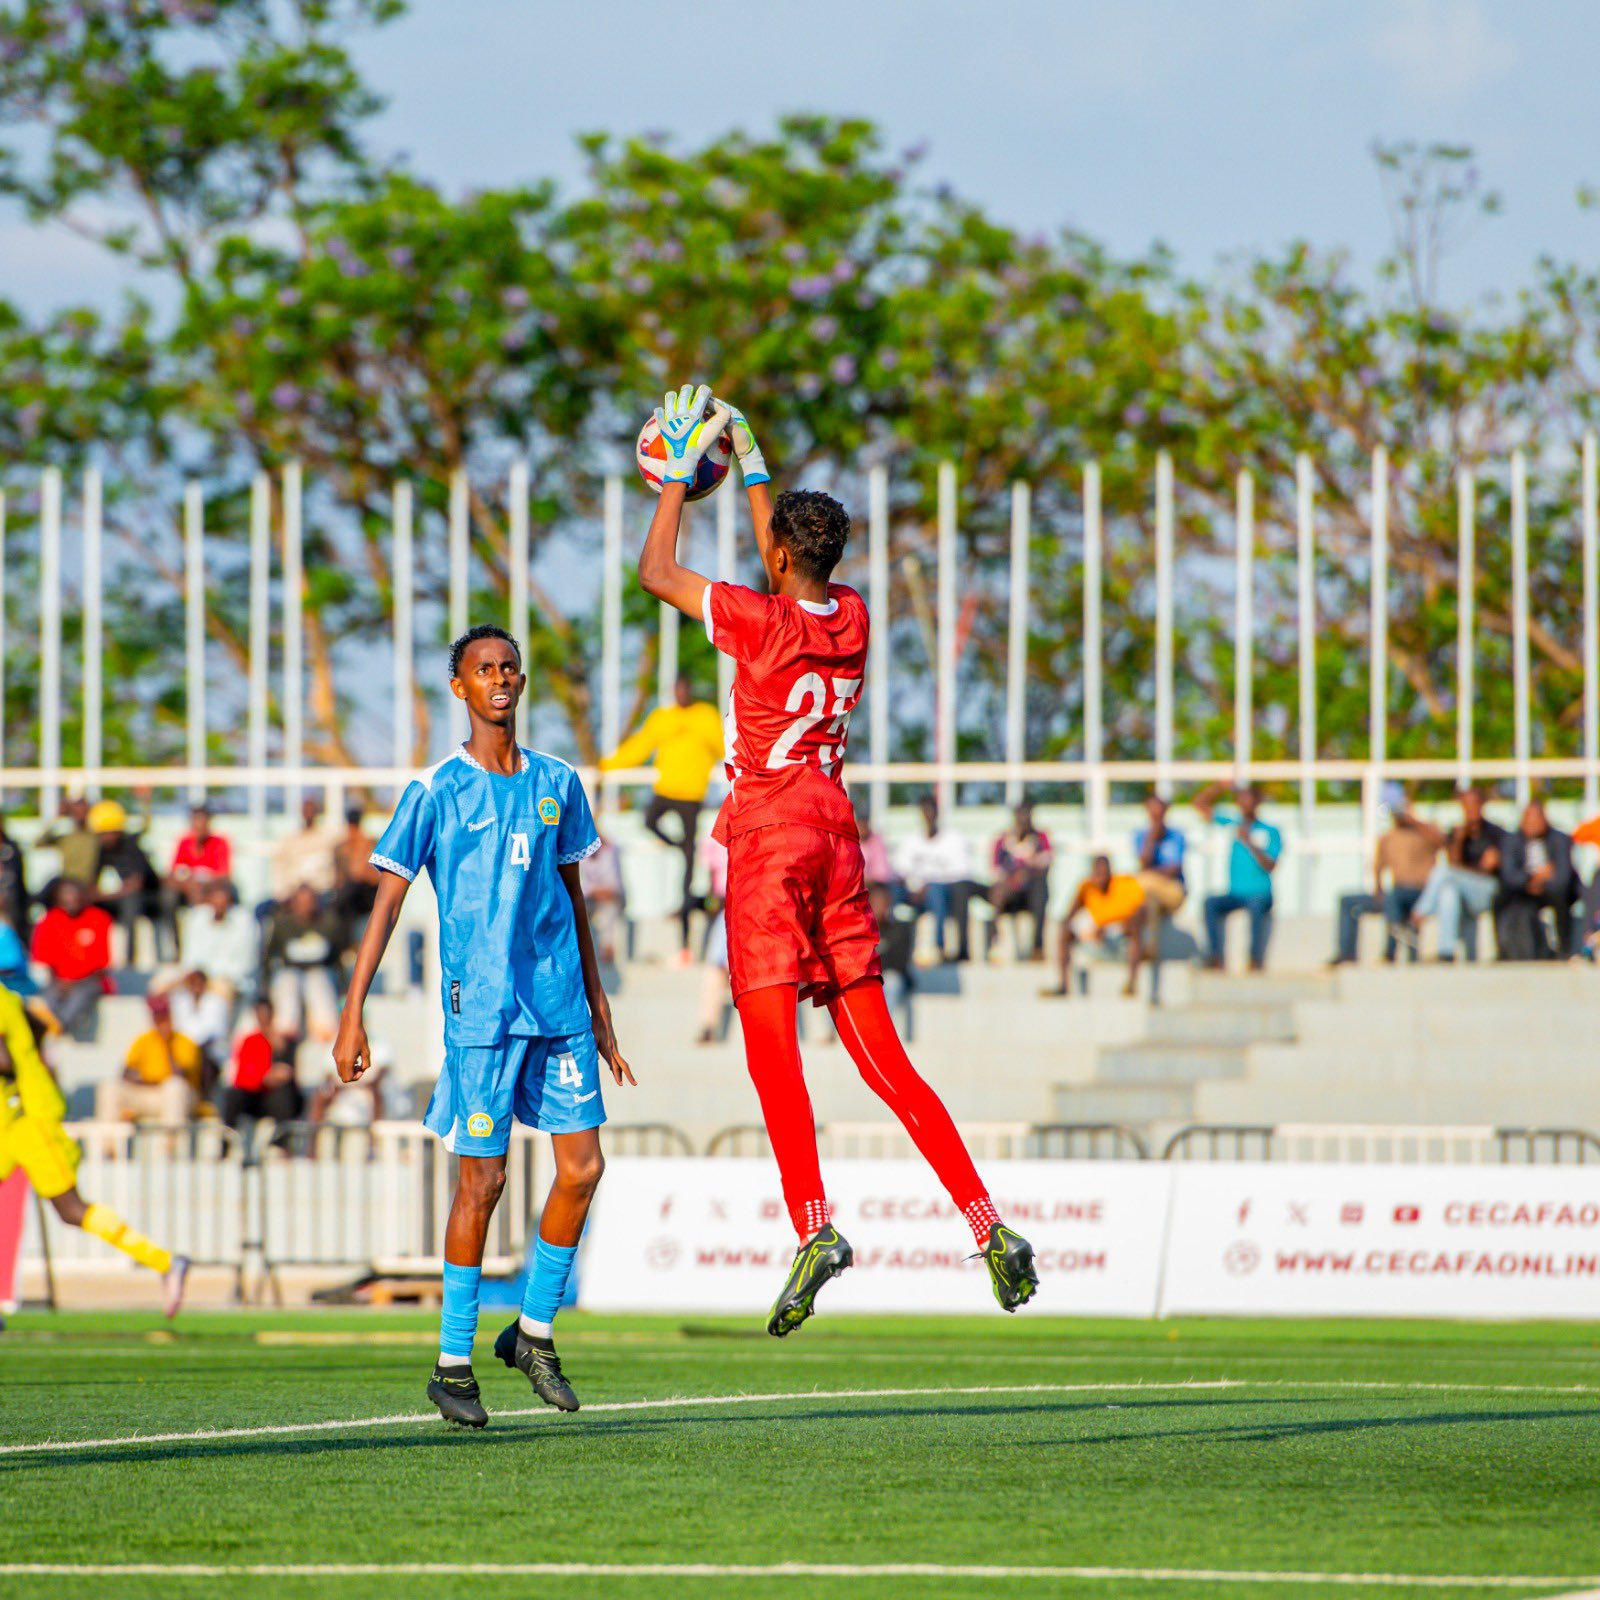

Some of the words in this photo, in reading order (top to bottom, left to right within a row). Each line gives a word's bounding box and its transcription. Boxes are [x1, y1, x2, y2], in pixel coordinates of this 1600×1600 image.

[511, 833, 531, 871] 4
[556, 1052, 583, 1088] 4
[859, 1198, 1104, 1222] CECAONLINE
